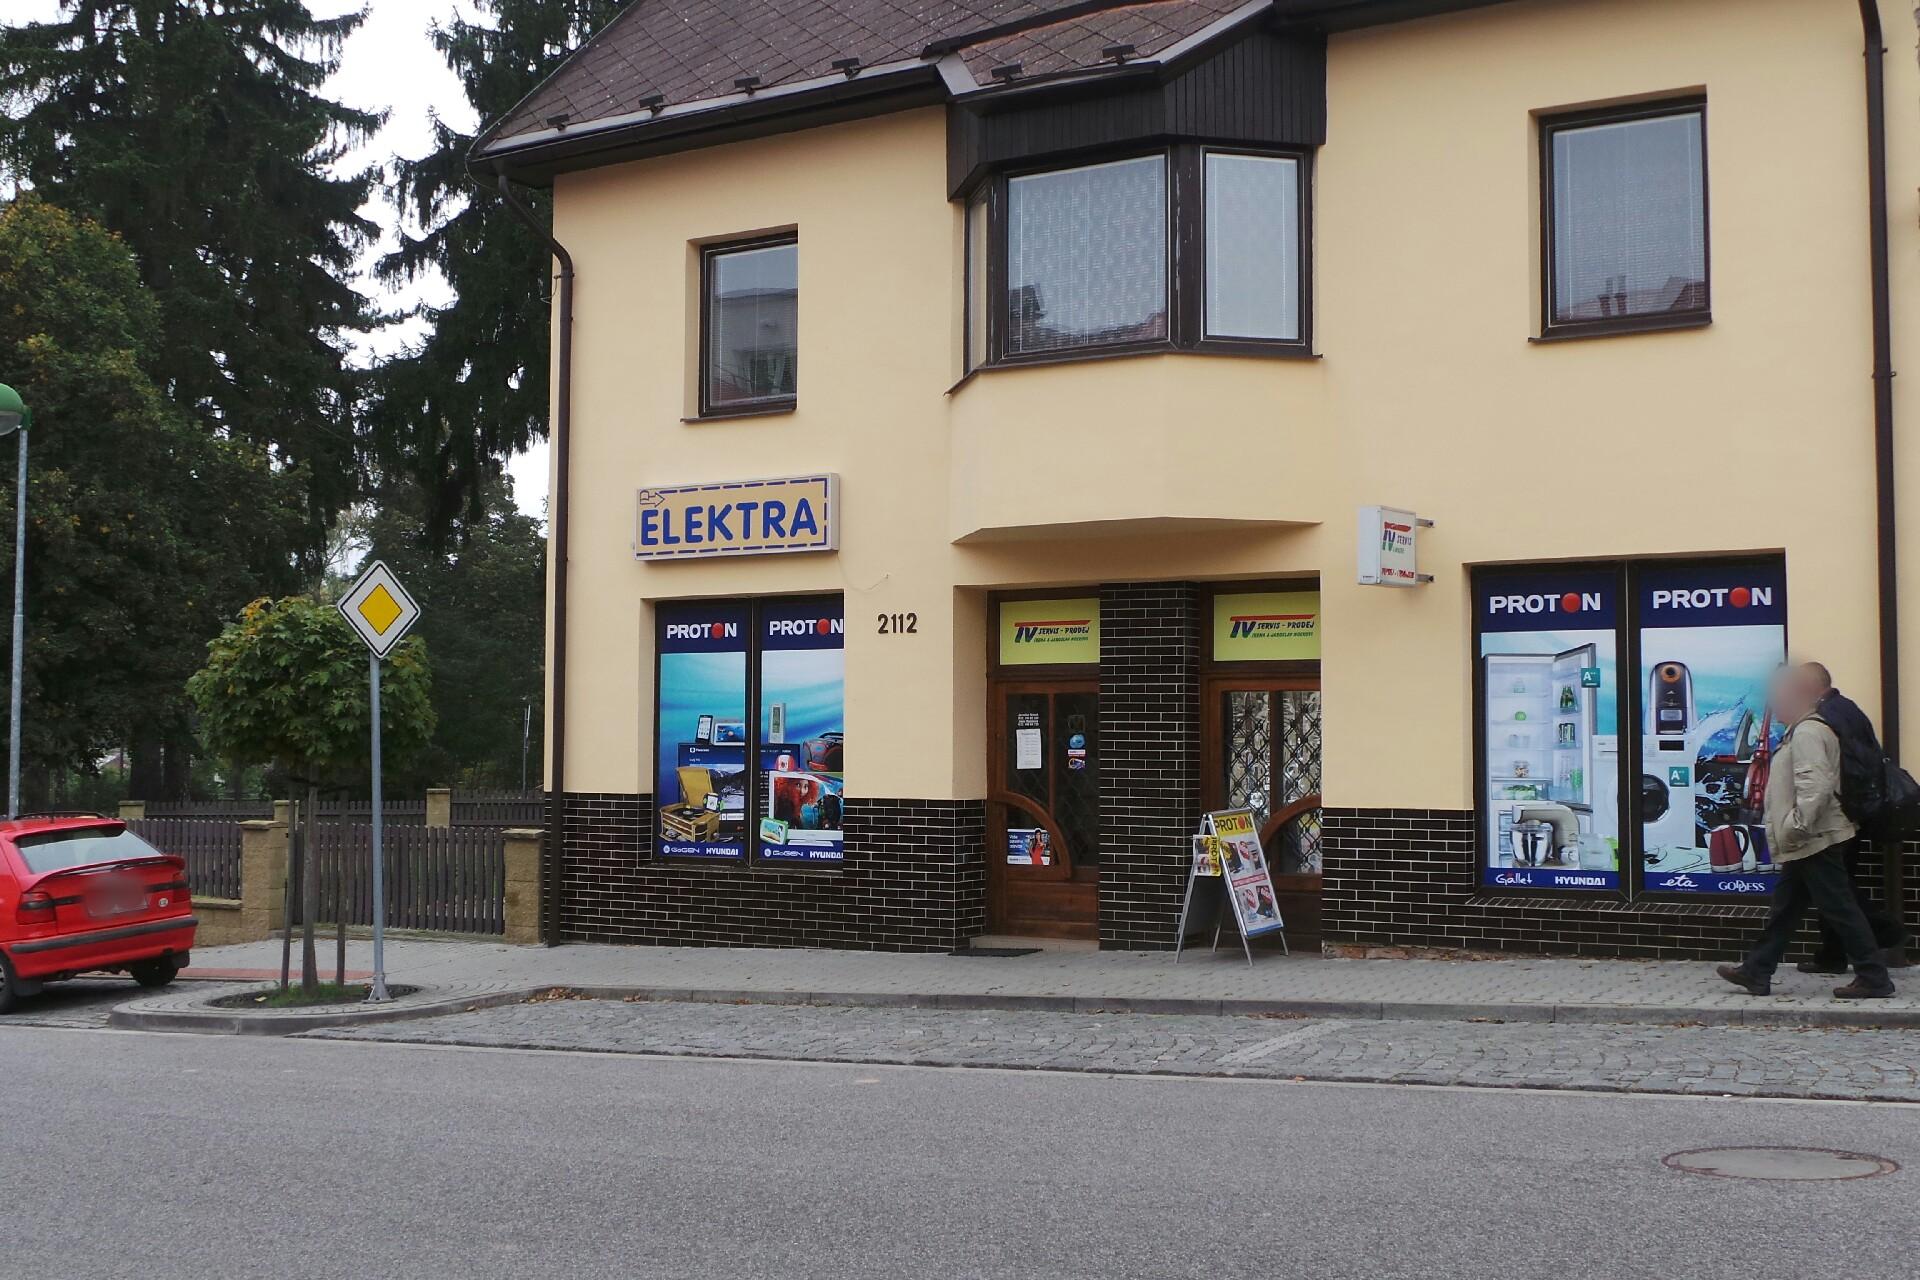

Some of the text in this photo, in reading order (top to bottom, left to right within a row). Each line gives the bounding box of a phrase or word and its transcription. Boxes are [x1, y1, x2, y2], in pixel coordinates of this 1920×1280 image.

[641, 497, 818, 546] ELEKTRA
[1489, 592, 1601, 614] PROTON
[1653, 587, 1772, 609] PROTON
[667, 622, 737, 639] PROTON
[769, 618, 844, 636] PROTON
[877, 613, 917, 634] 2112
[1038, 627, 1060, 635] SERVIS
[1064, 626, 1090, 634] PRODEJ
[1287, 620, 1315, 629] PRODEJ
[1214, 815, 1253, 832] PROTON
[706, 847, 739, 856] HYUNDAI
[1554, 876, 1606, 886] HYUNDAI
[1659, 874, 1765, 893] eta GODDESS
